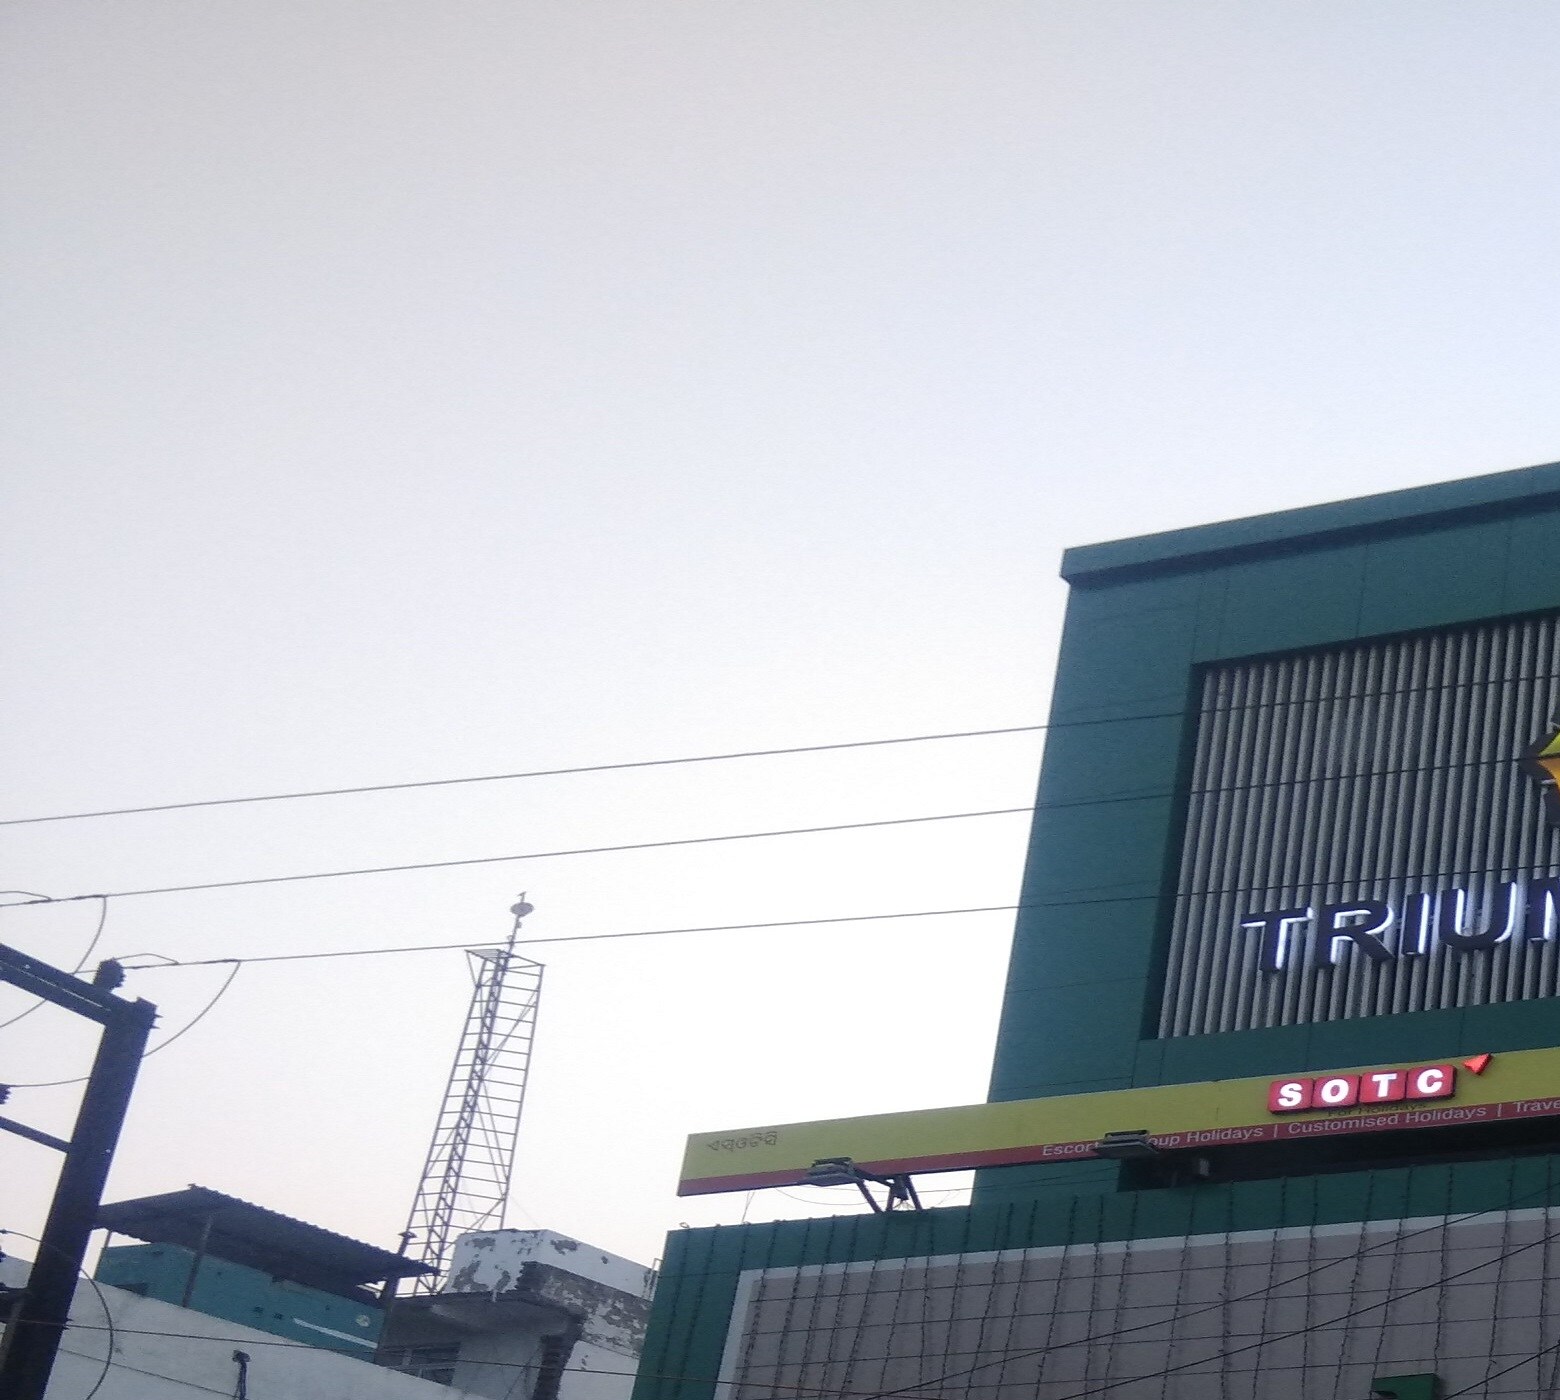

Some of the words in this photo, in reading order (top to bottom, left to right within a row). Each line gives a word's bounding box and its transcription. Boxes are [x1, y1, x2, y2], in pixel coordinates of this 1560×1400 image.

[1277, 1066, 1445, 1109] SOTC
[1042, 1141, 1100, 1157] Escort
[1187, 1126, 1264, 1144] Holidays
[1288, 1112, 1399, 1136] Customised
[1405, 1103, 1487, 1125] Holidays
